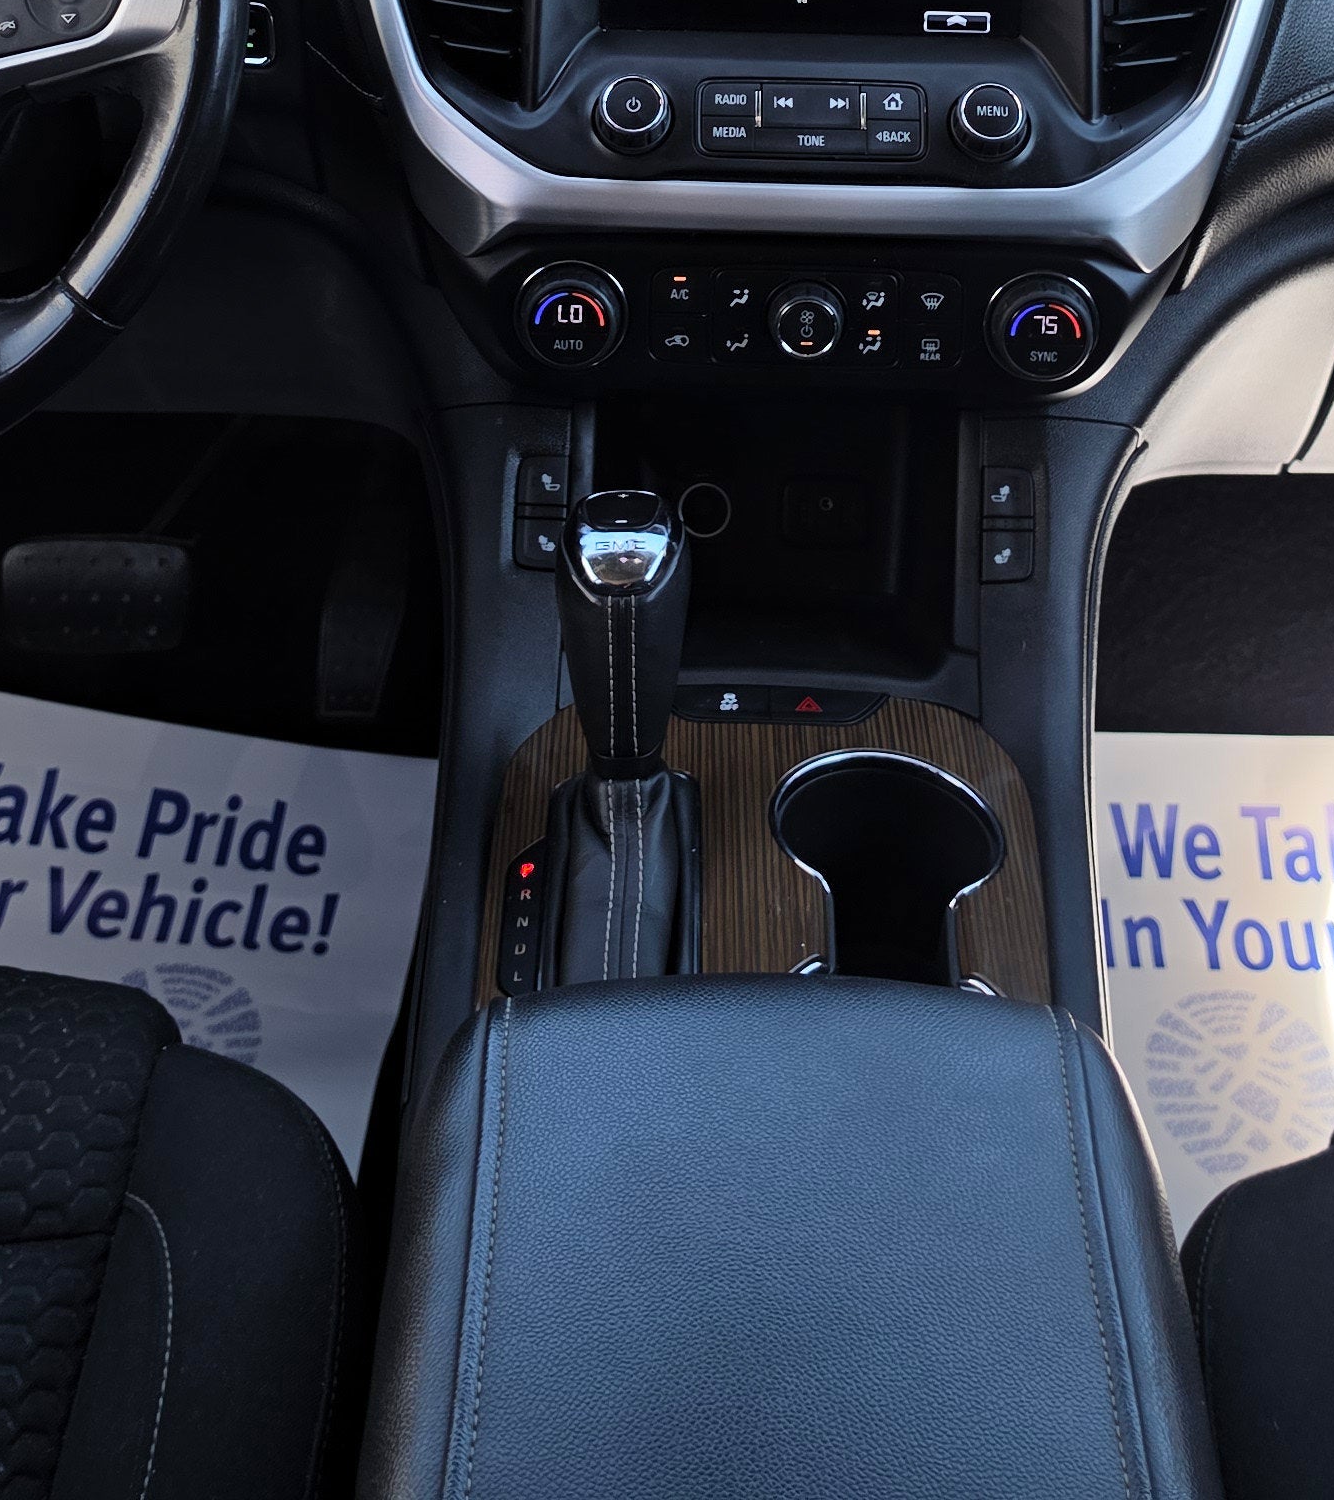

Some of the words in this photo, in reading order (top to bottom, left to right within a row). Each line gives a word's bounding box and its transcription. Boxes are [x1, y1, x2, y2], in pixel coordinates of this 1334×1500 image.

[714, 93, 748, 106] RADIO
[976, 104, 1010, 118] MENU
[712, 125, 747, 139] MEDIA
[882, 130, 911, 144] BACK
[797, 134, 826, 148] TONE
[670, 288, 690, 302] A/C
[1033, 315, 1059, 335] 75
[553, 338, 584, 352] AUTO
[920, 352, 942, 362] REAR
[1030, 349, 1058, 364] SYNC
[594, 538, 646, 551] GMC
[137, 787, 327, 876] Pride
[1109, 802, 1222, 881] We
[520, 888, 532, 901] R
[46, 865, 342, 956] Vehicle!
[516, 916, 529, 928] N
[1103, 899, 1167, 970] In
[514, 943, 527, 955] D
[513, 971, 523, 982] L
